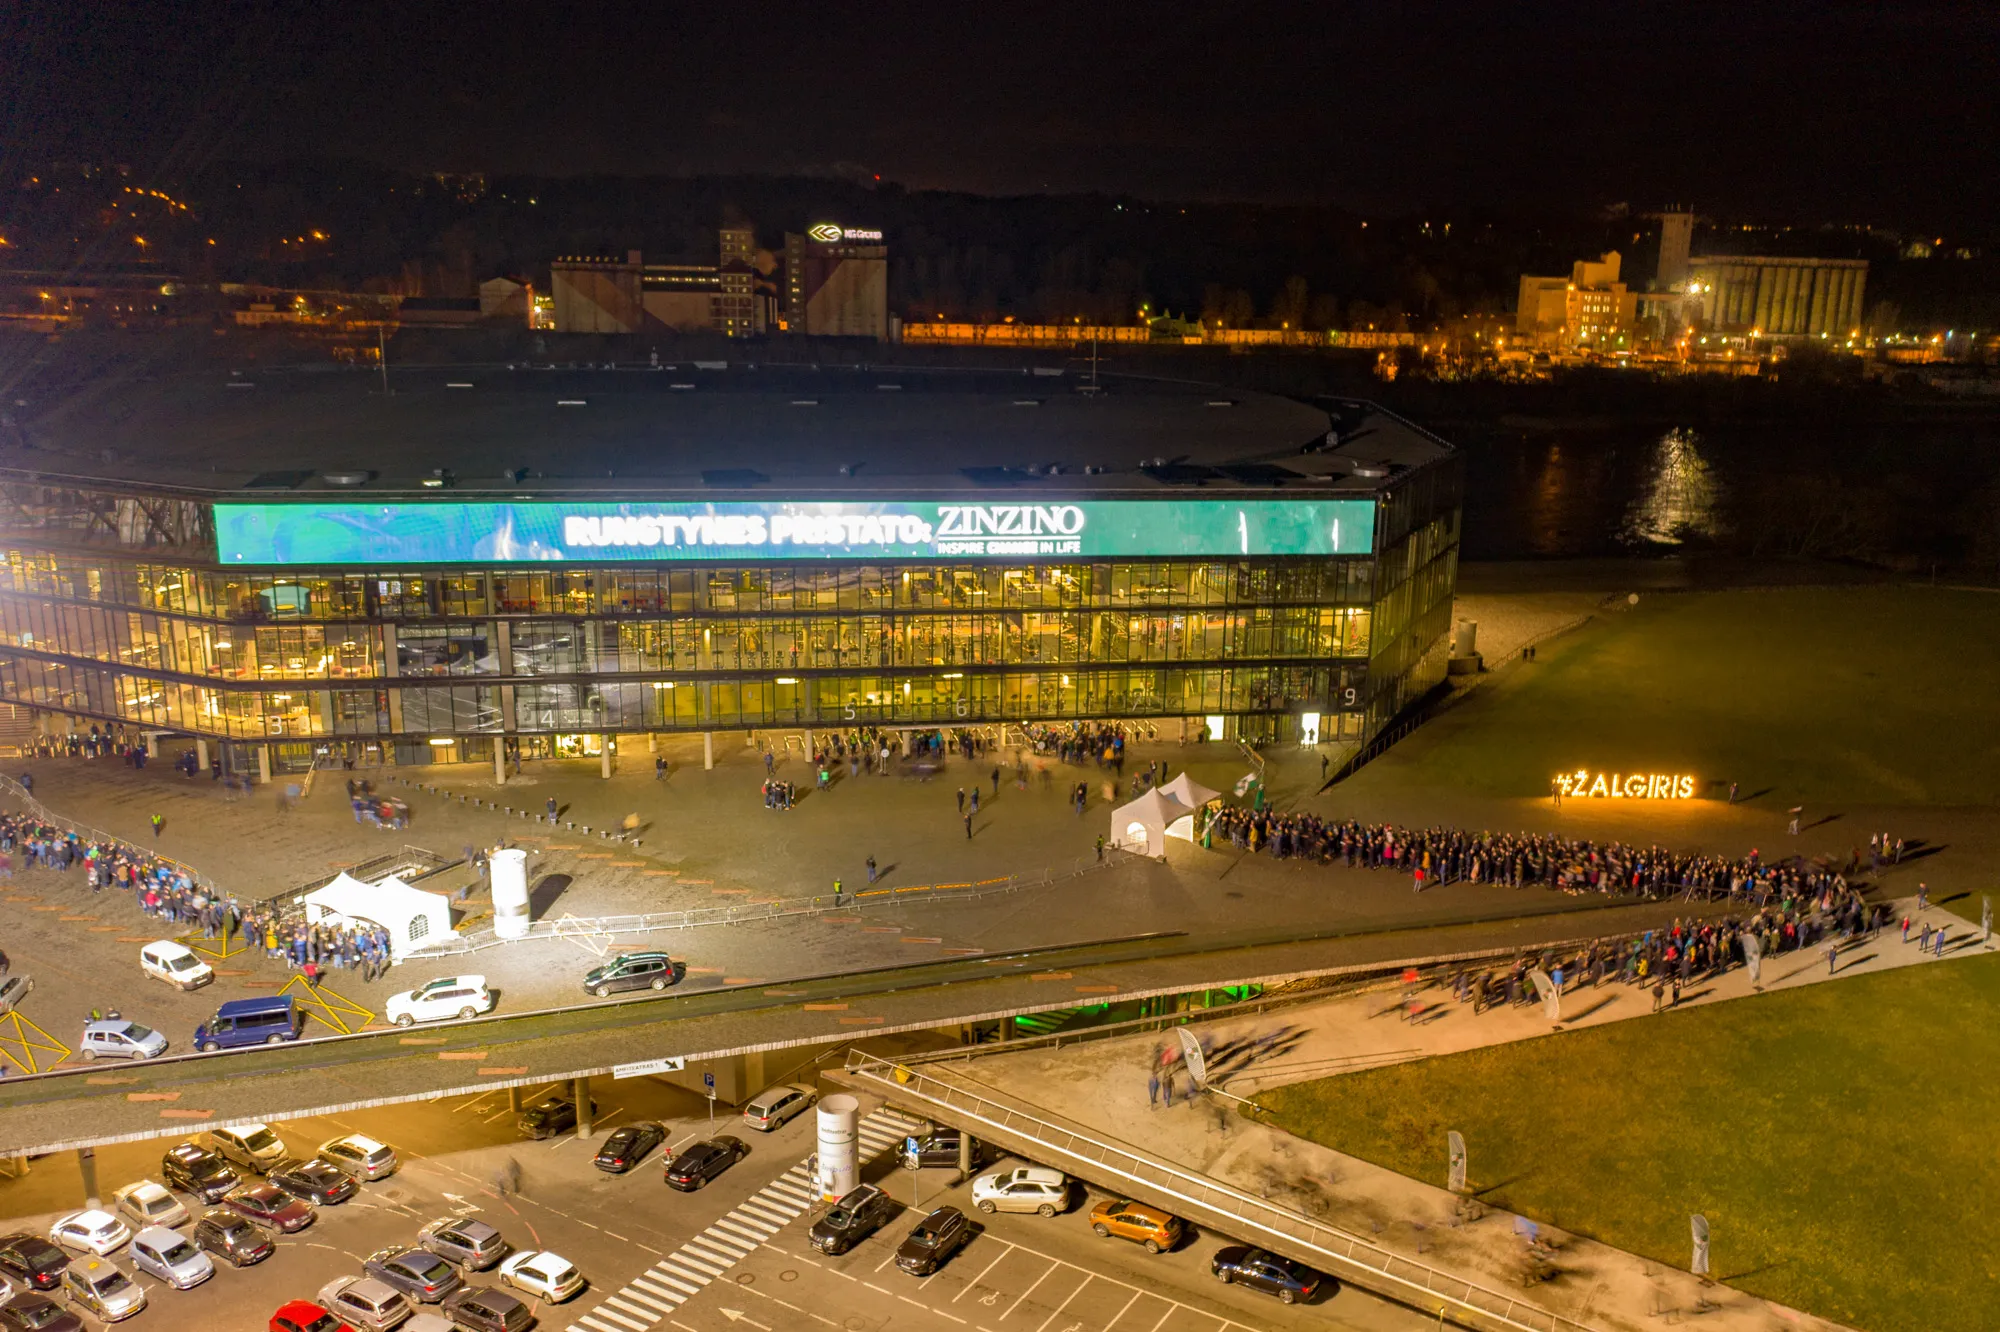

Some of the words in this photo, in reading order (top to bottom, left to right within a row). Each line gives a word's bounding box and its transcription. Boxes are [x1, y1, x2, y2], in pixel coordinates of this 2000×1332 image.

[937, 505, 1085, 535] ZINZINO
[938, 542, 985, 555] INSPIRE
[1040, 541, 1054, 554] IN
[1056, 541, 1081, 554] LIFE
[1344, 688, 1356, 706] 9
[844, 702, 856, 720] 5
[956, 698, 967, 717] 6
[270, 715, 282, 735] 3
[540, 709, 555, 728] 4
